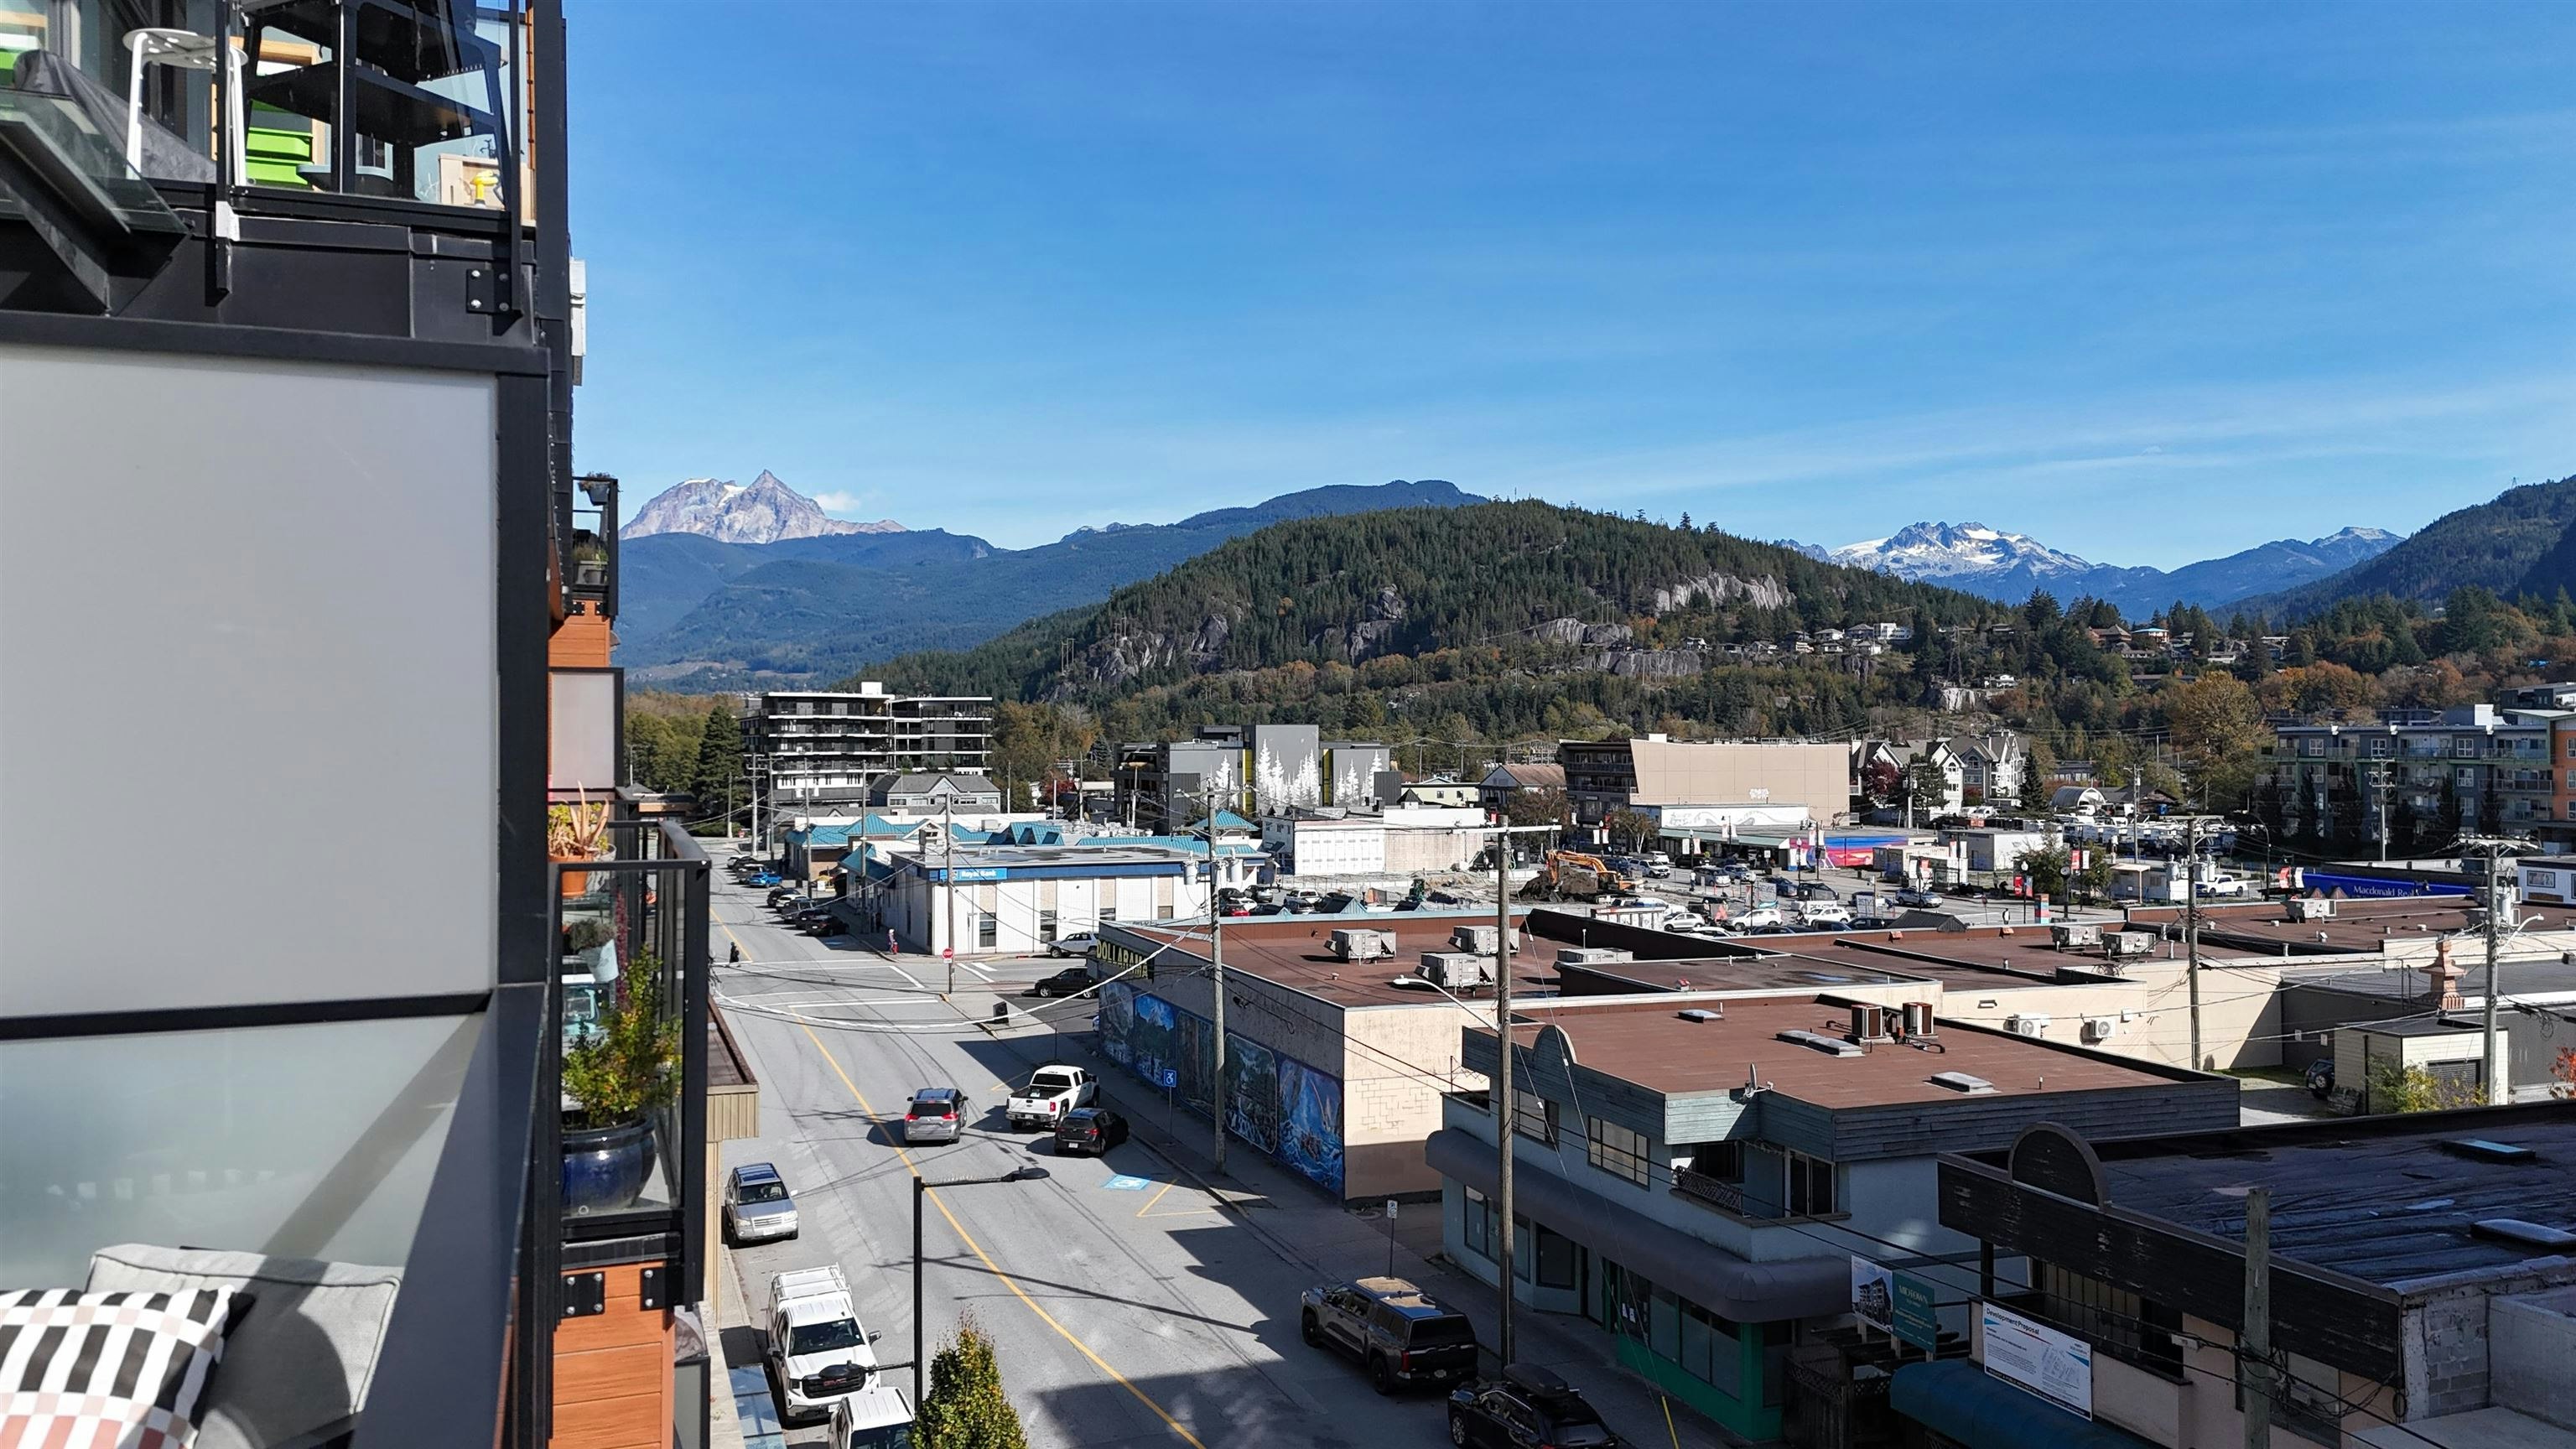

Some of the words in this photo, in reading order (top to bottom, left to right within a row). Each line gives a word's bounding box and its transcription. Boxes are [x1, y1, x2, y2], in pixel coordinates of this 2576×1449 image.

[2354, 886, 2395, 896] Macdonald
[1096, 938, 1148, 979] DOLLARAMA
[1987, 1307, 2018, 1327] Development
[2018, 1320, 2039, 1335] Proposal
